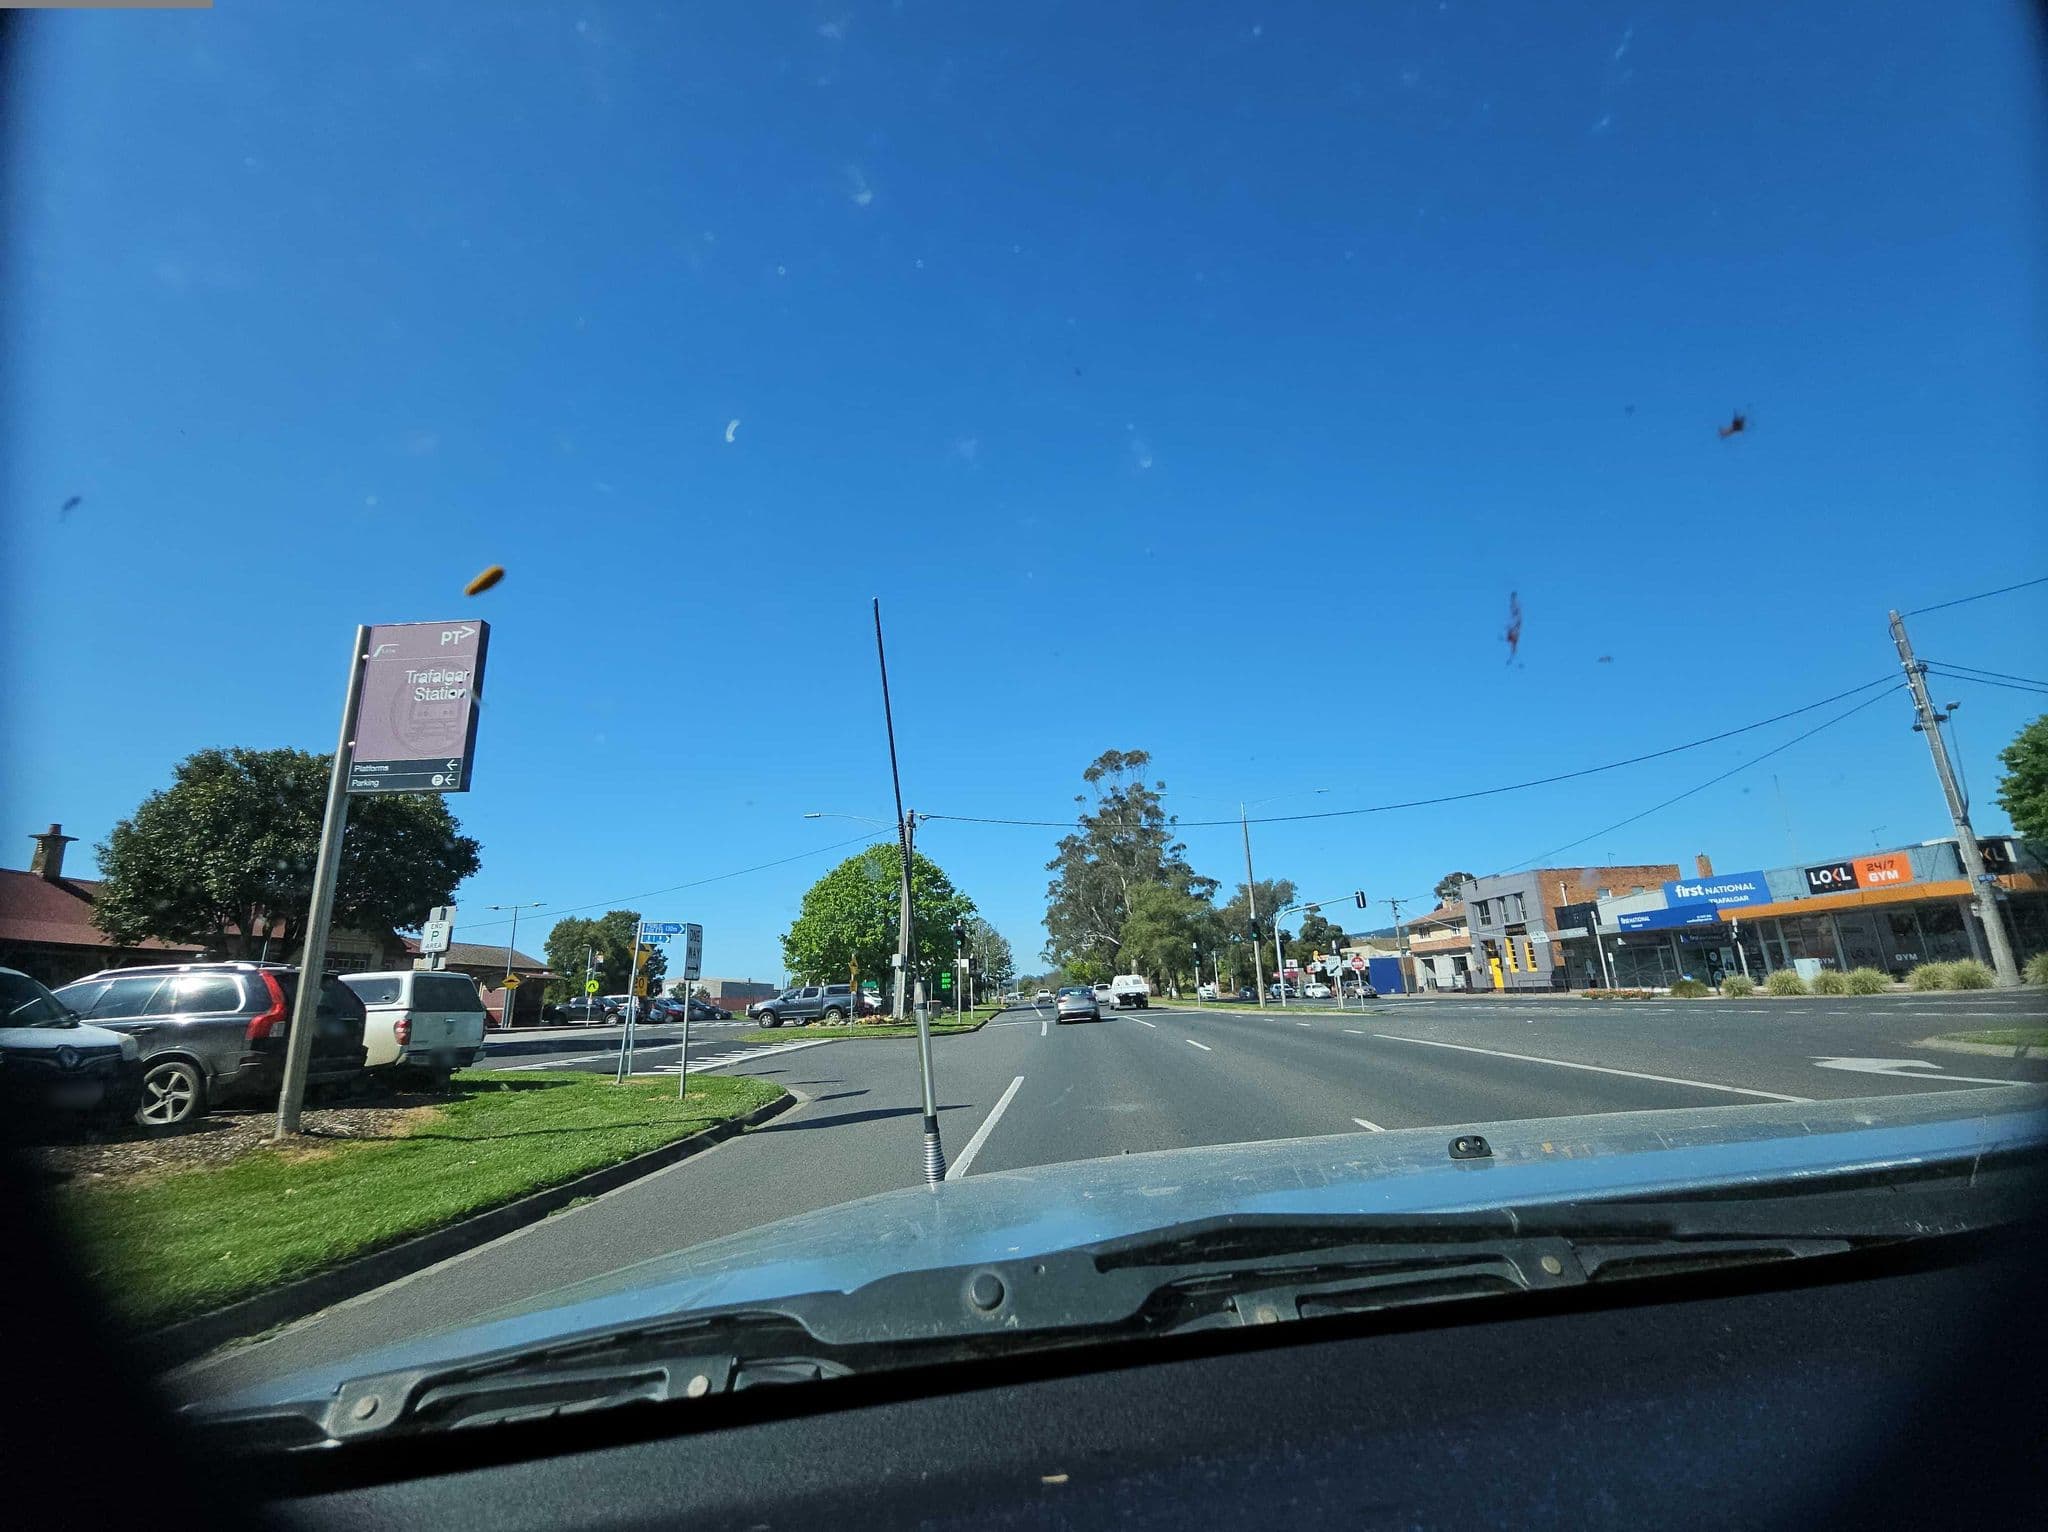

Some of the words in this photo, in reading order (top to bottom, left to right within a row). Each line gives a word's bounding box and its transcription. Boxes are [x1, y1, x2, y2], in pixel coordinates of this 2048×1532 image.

[405, 669, 470, 686] Trafalgar
[414, 686, 467, 702] Station
[354, 764, 389, 773] Platforms
[352, 778, 380, 788] Parking
[1866, 860, 1894, 872] 24/7
[1868, 870, 1900, 883] GYM
[1675, 885, 1704, 898] first
[1704, 882, 1756, 896] NATIONAL
[1708, 895, 1750, 904] TRAFALGAR
[431, 931, 439, 941] P
[689, 928, 701, 943] ONE
[1895, 953, 1918, 961] GYM
